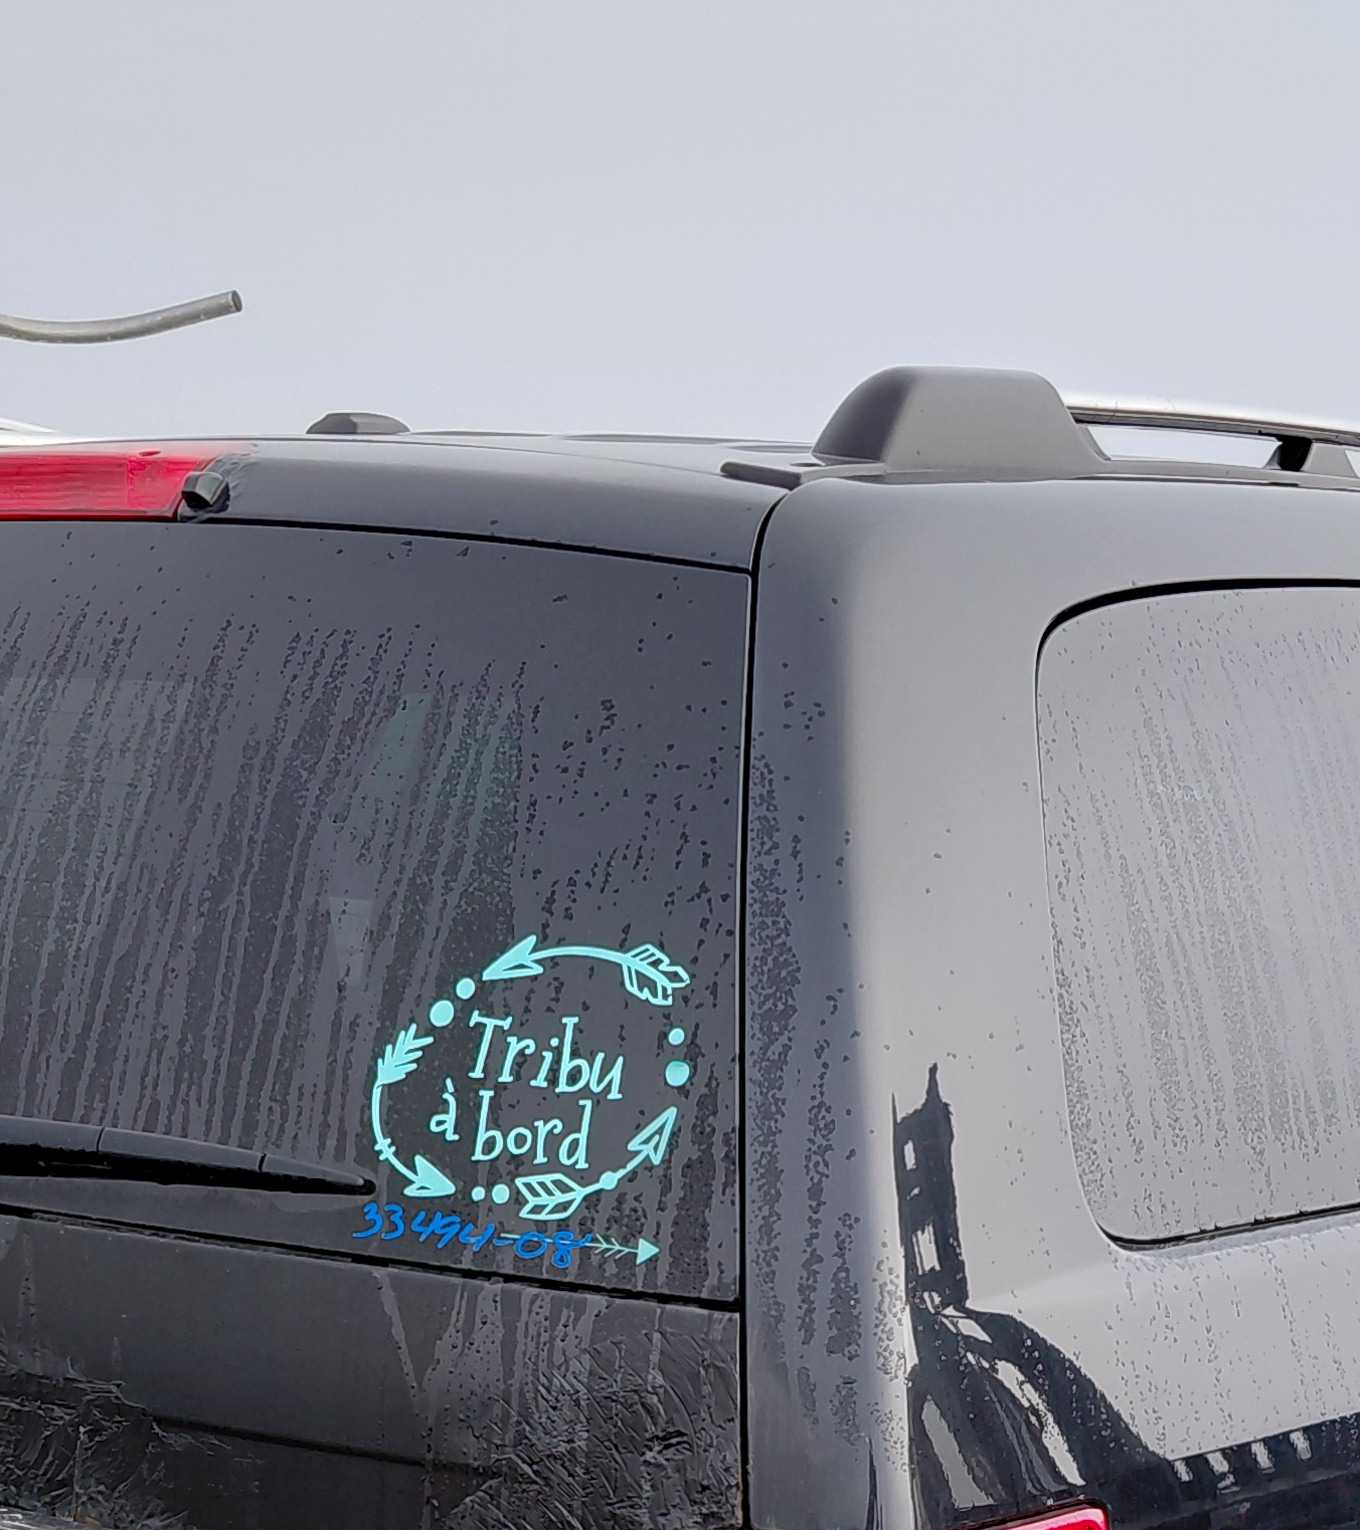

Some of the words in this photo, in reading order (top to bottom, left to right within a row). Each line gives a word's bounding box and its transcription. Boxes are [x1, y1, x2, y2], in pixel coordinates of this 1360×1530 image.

[468, 1009, 625, 1100] Tribu
[429, 1076, 461, 1141] à
[470, 1089, 594, 1171] bord
[352, 1202, 594, 1269] 33494-08
